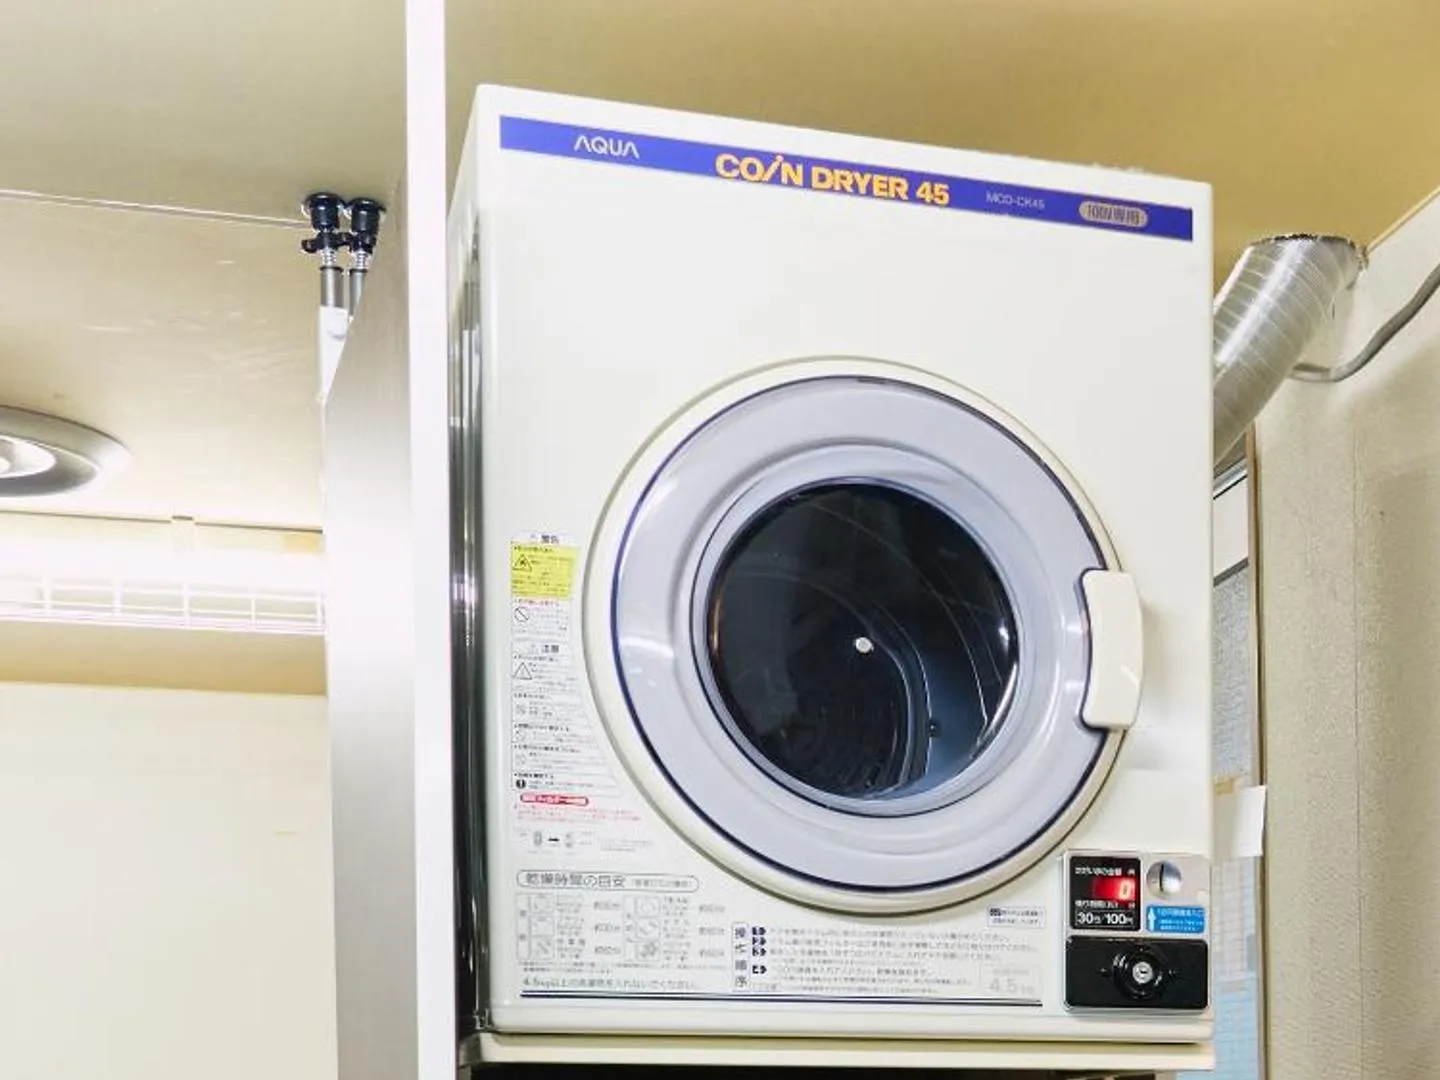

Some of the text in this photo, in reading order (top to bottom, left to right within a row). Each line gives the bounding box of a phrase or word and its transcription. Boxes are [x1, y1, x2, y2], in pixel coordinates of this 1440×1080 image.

[574, 134, 640, 160] AQUA
[715, 153, 950, 206] COIN DRYER 45
